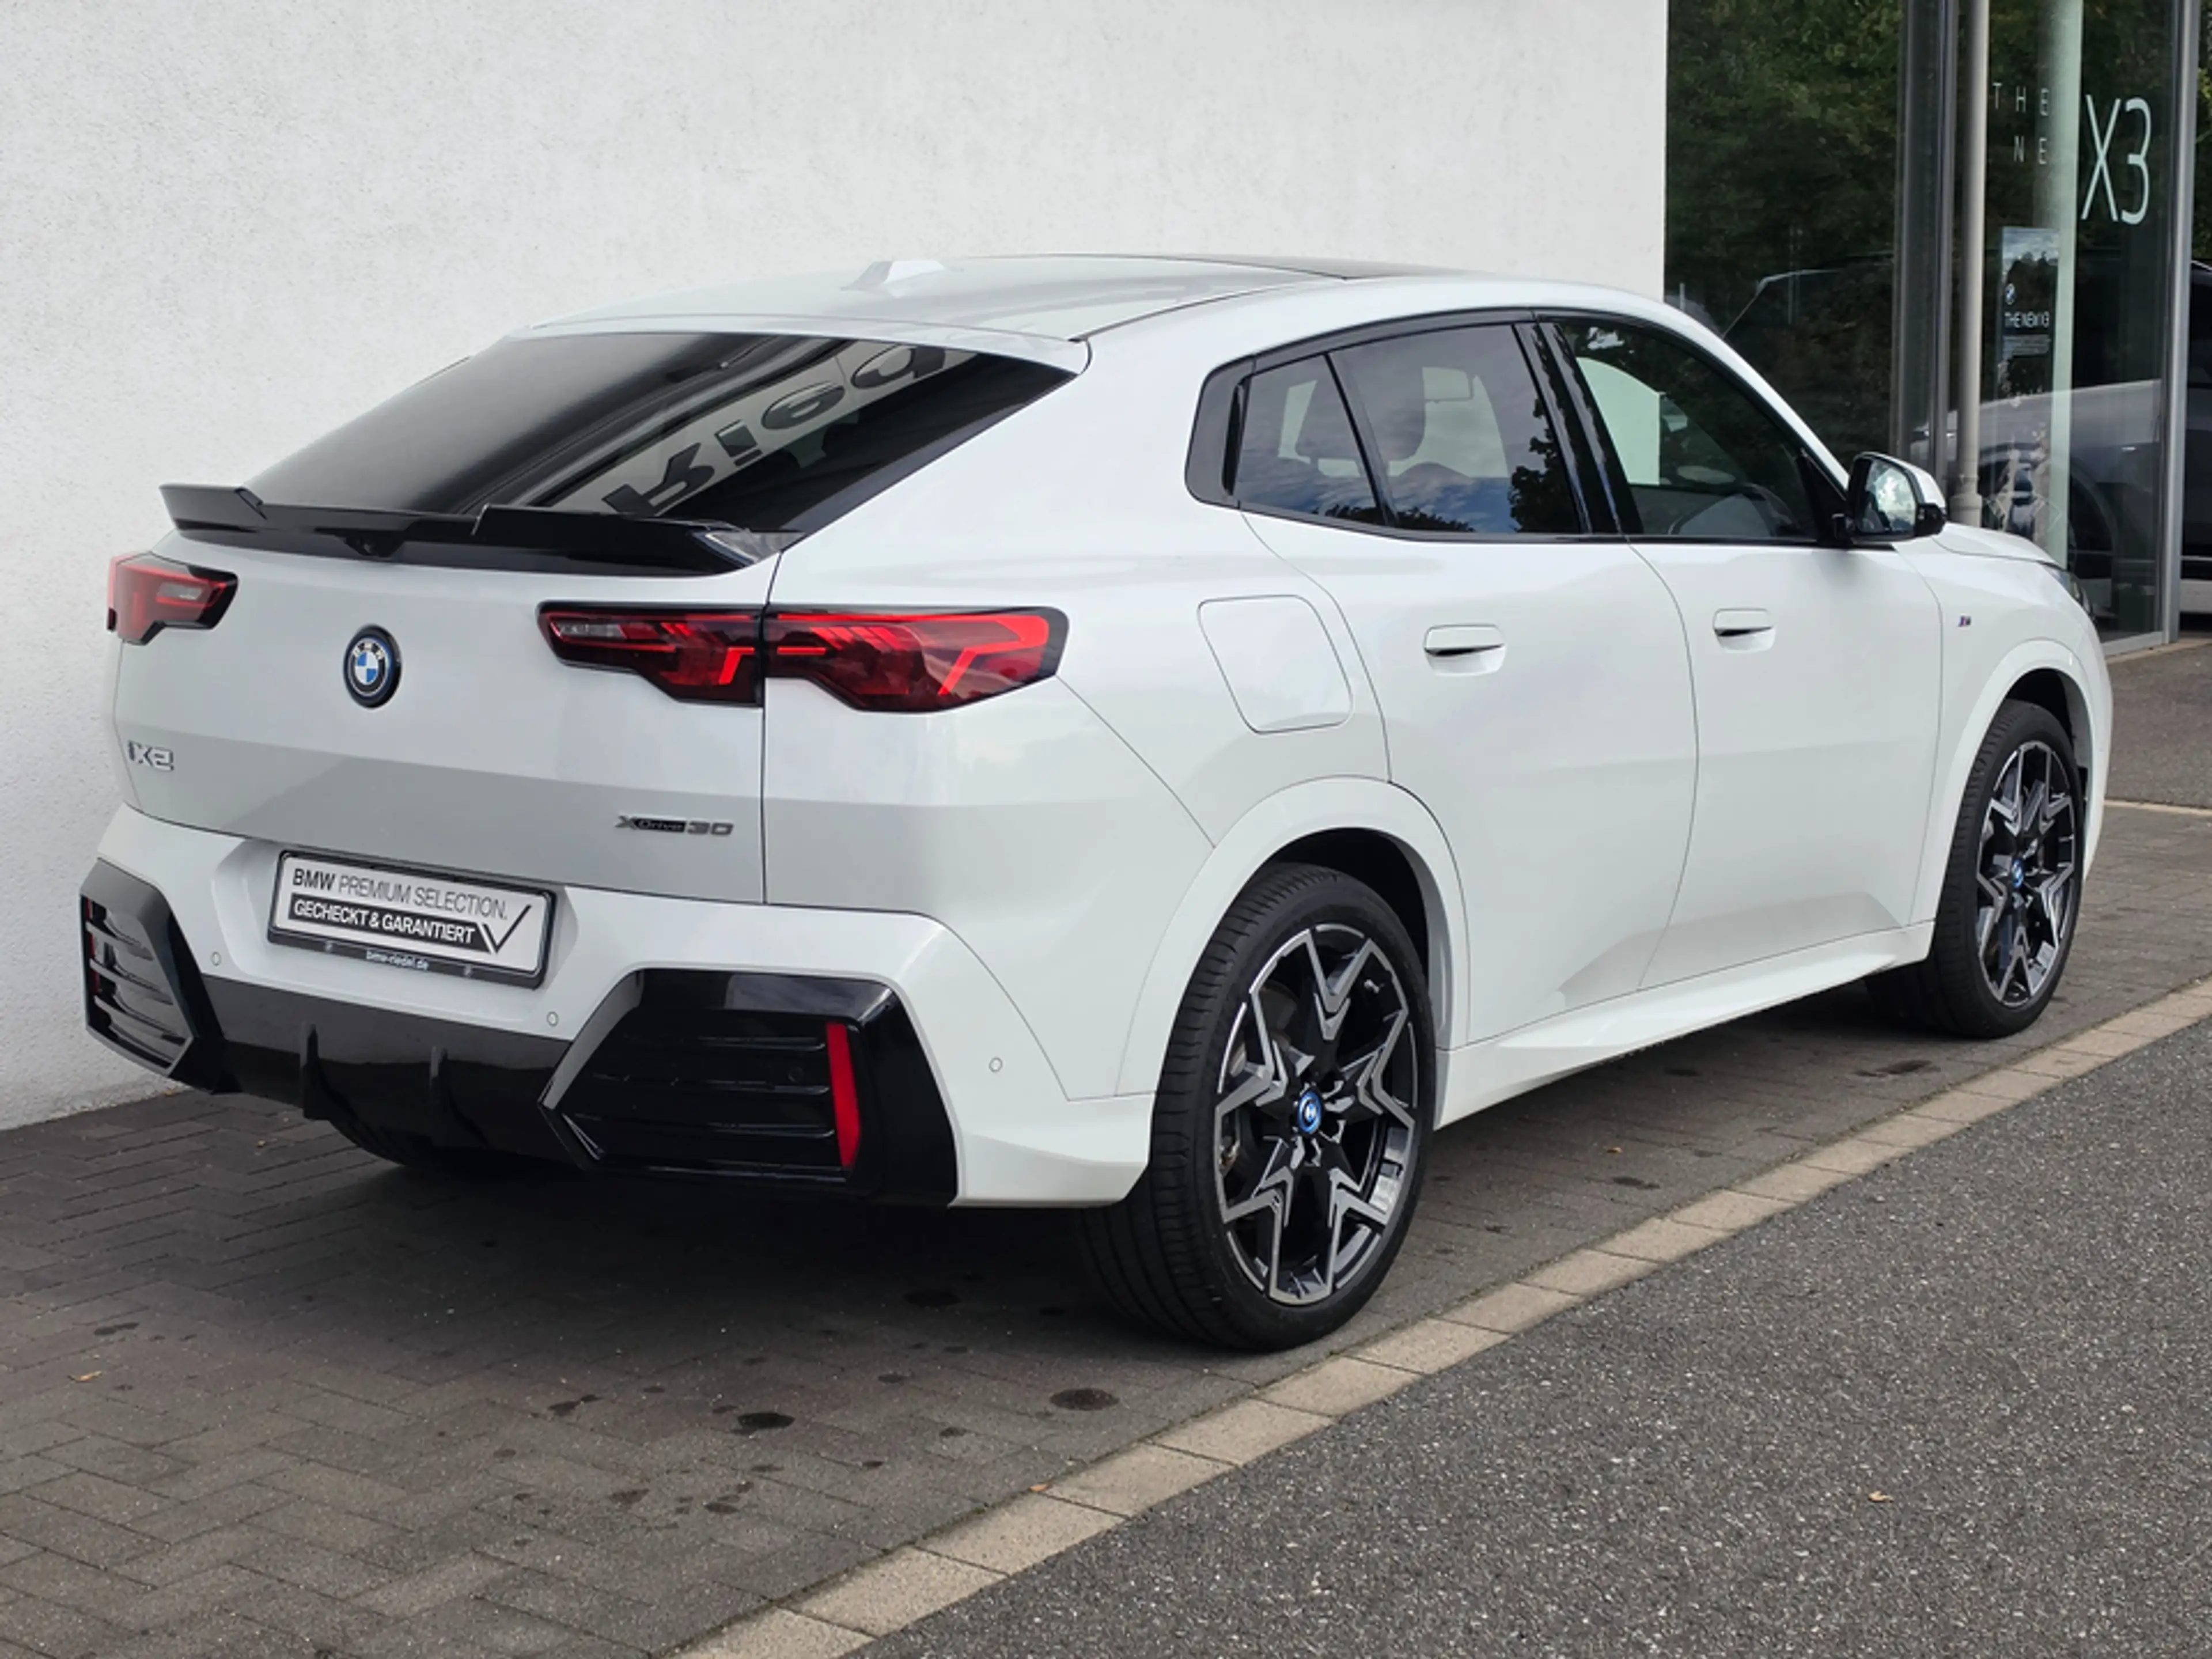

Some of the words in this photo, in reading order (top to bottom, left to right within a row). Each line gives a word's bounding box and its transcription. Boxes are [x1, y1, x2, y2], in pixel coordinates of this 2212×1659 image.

[2081, 94, 2152, 225] X3
[688, 820, 734, 835] 30
[293, 868, 335, 891] BMW
[338, 875, 411, 904] PREMIUM
[294, 899, 366, 925] GECHECKT
[369, 912, 380, 927] &
[382, 915, 475, 943] GARANTIERT
